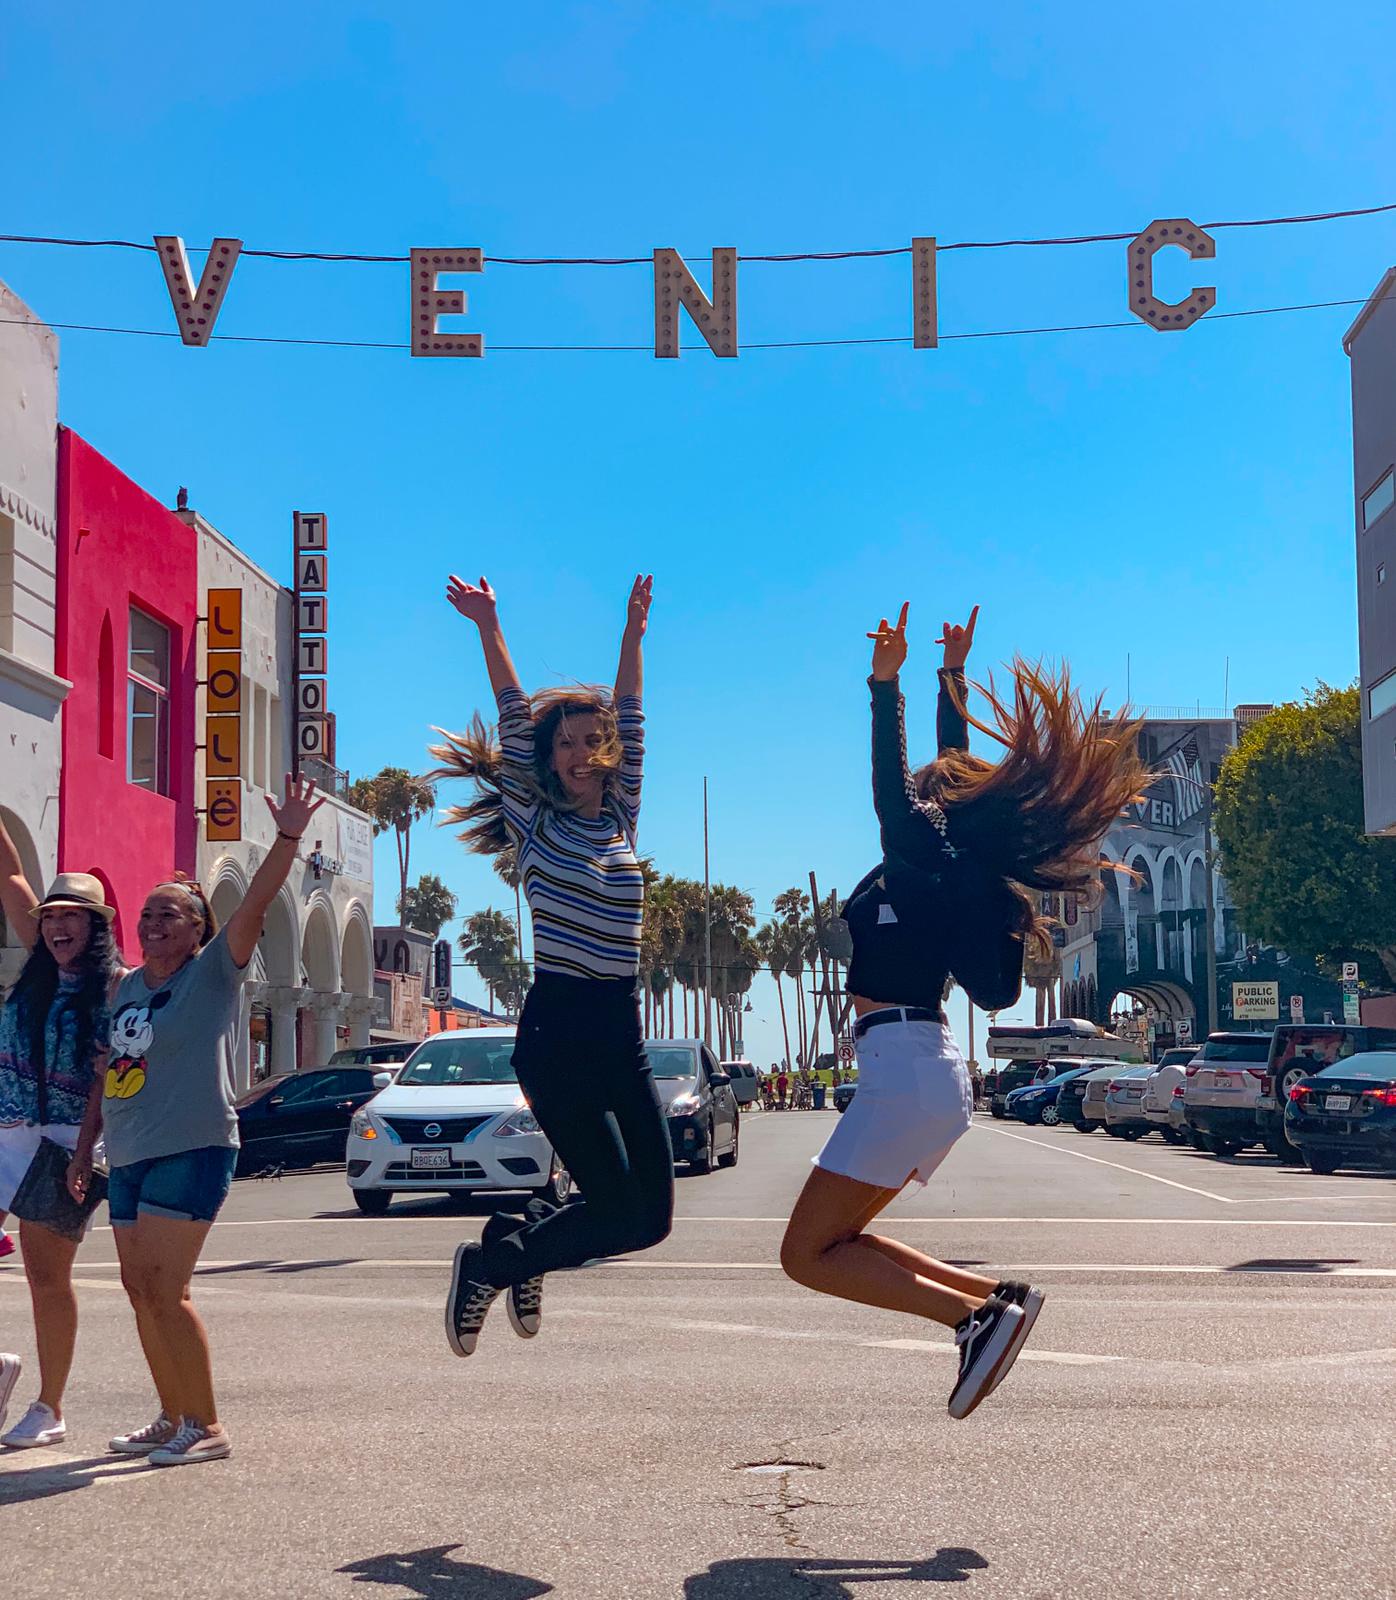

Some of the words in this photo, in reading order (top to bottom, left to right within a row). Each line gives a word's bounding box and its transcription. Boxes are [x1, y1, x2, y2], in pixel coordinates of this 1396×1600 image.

[301, 518, 320, 751] TATTOO
[1238, 987, 1273, 996] PUBLIC
[1236, 997, 1276, 1007] PARKING
